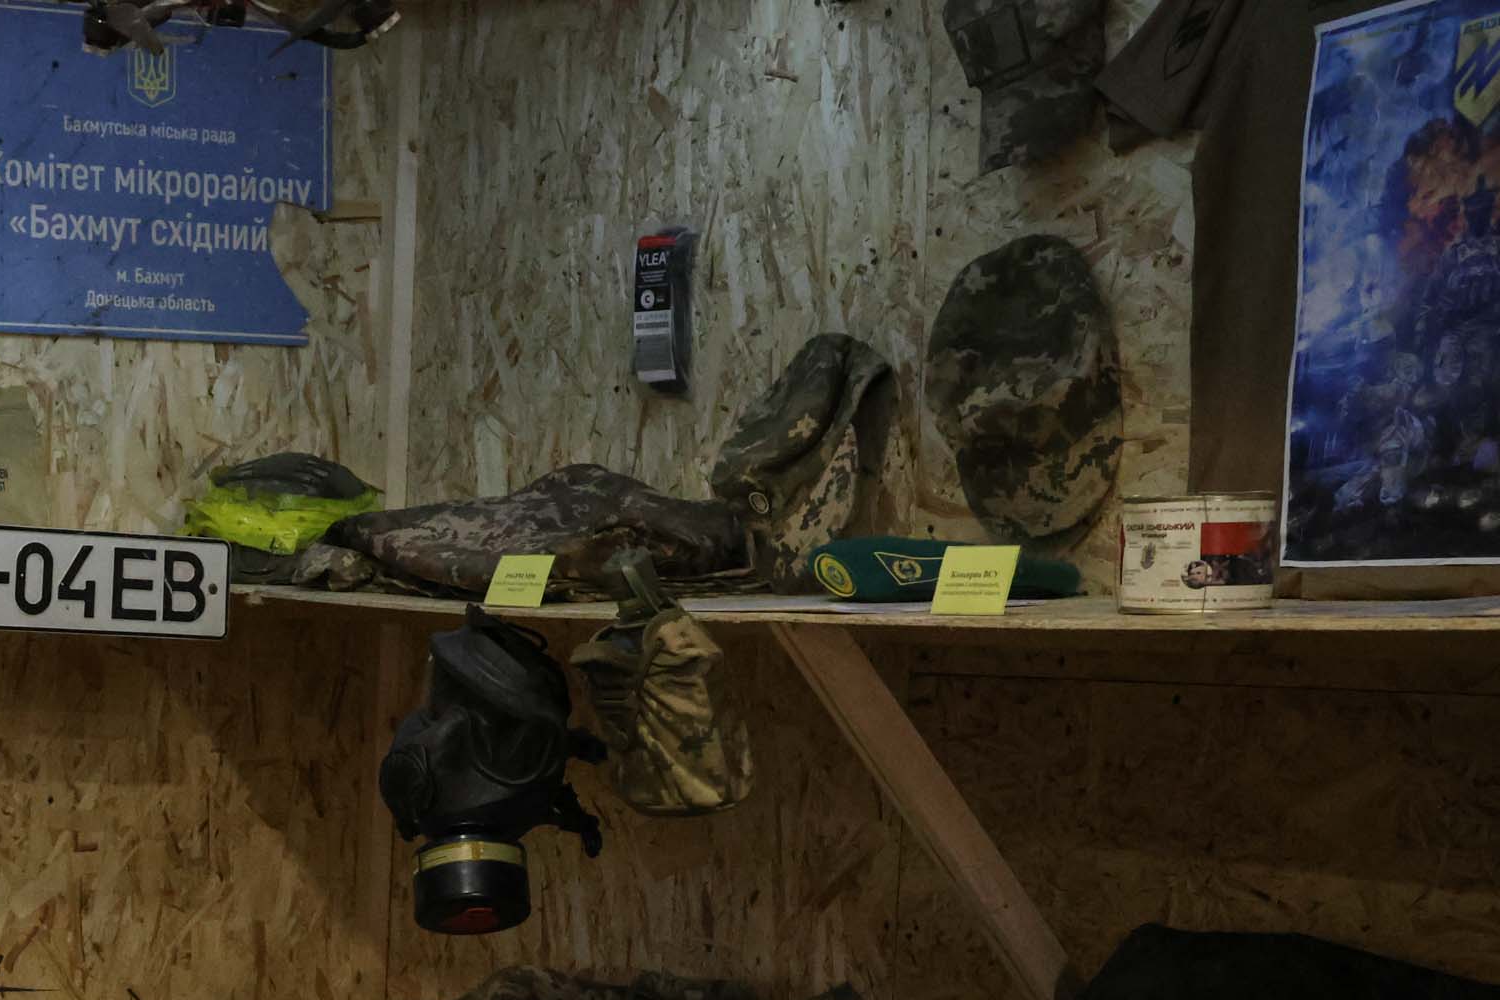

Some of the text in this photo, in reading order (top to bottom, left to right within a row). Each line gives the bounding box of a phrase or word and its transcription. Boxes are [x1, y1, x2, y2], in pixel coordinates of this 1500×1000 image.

[63, 115, 236, 145] Бахмутська міська рада
[115, 160, 312, 206] мікрорайону
[10, 204, 141, 250] «Бахмут
[116, 267, 185, 286] м. Бахмут
[85, 290, 215, 313] Донецька область
